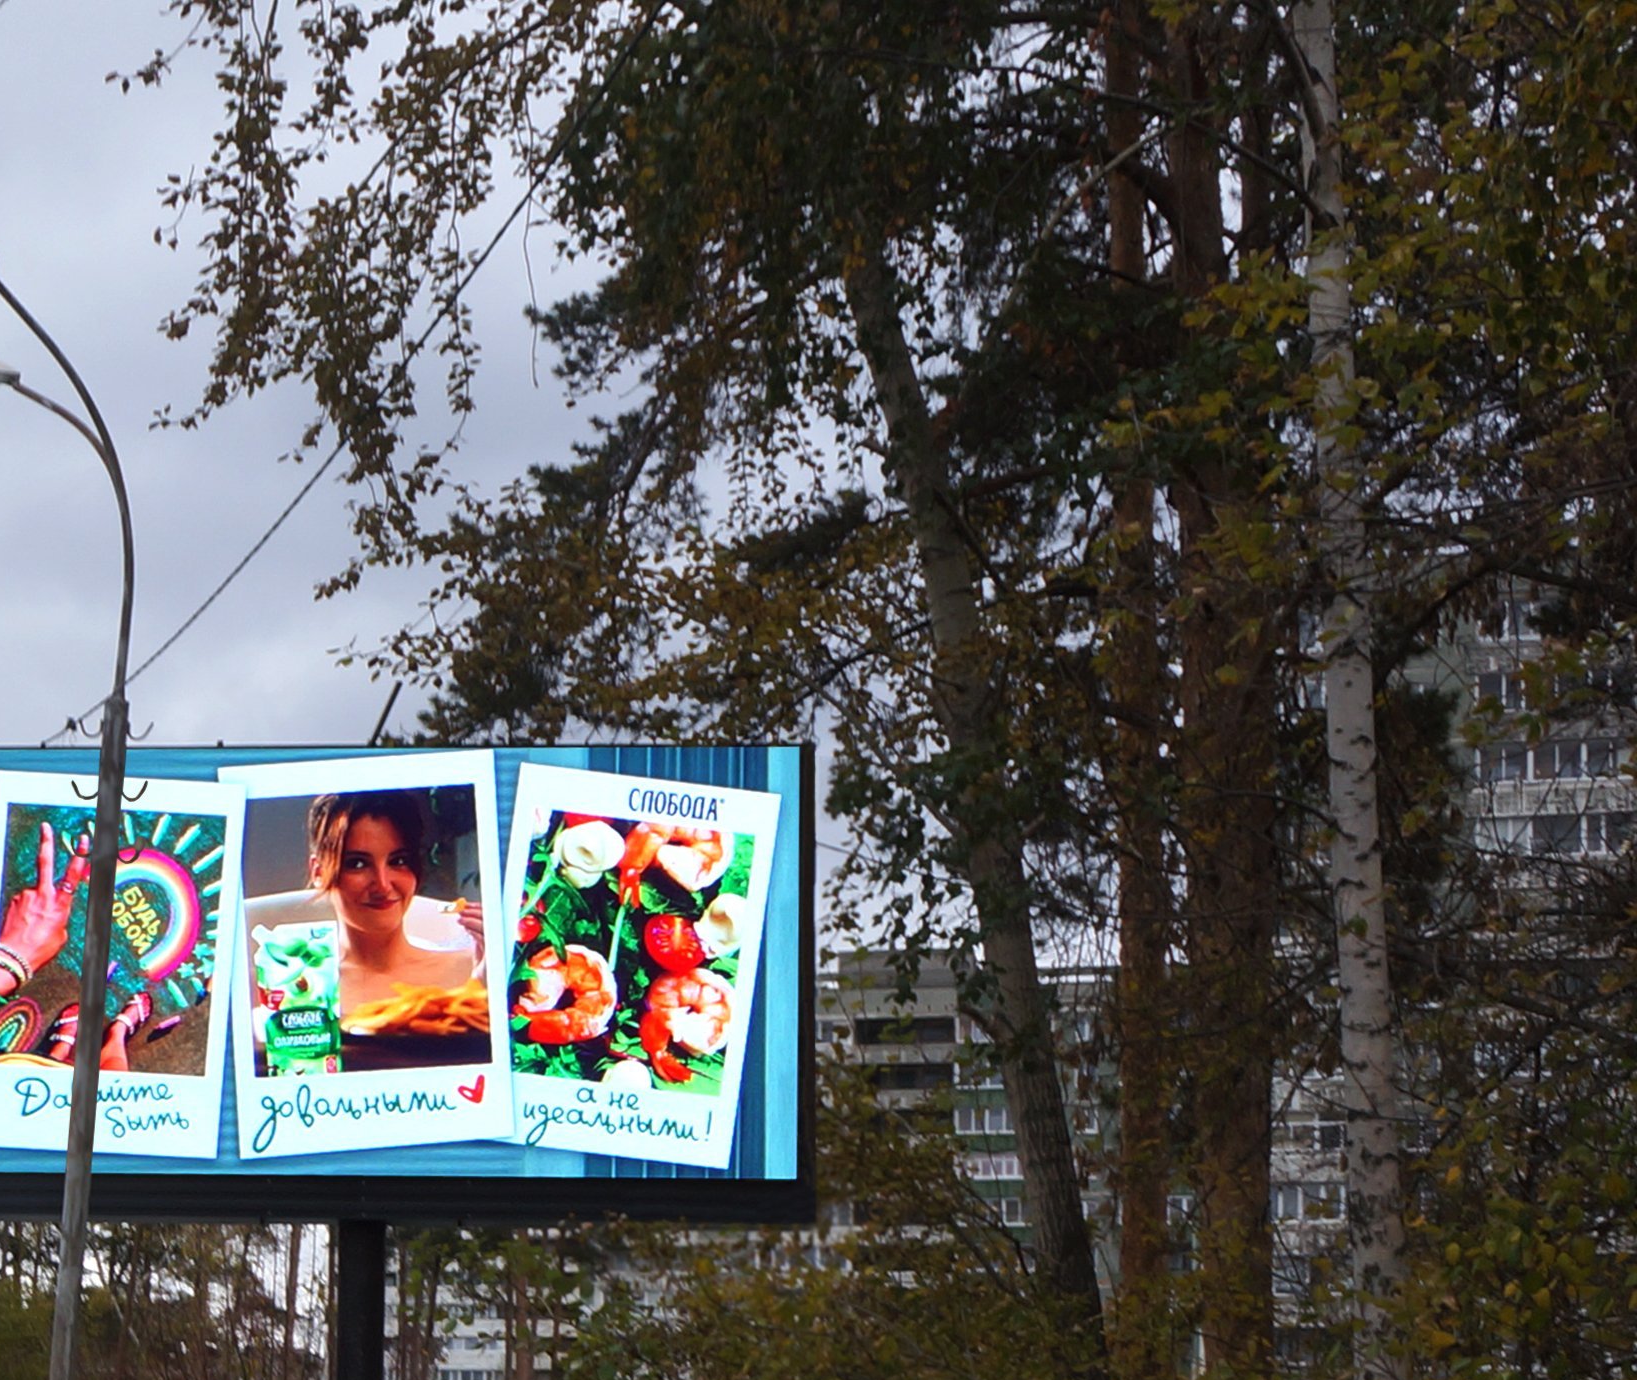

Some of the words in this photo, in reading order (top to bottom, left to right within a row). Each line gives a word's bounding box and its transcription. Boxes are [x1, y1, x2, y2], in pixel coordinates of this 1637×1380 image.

[628, 788, 719, 821] СЛОБОДА
[111, 897, 154, 955] ОБОЙ
[122, 886, 161, 936] БУДЬ
[14, 1077, 174, 1117] Даайте
[576, 1087, 597, 1103] а
[609, 1091, 639, 1111] не
[105, 1106, 190, 1138] быть
